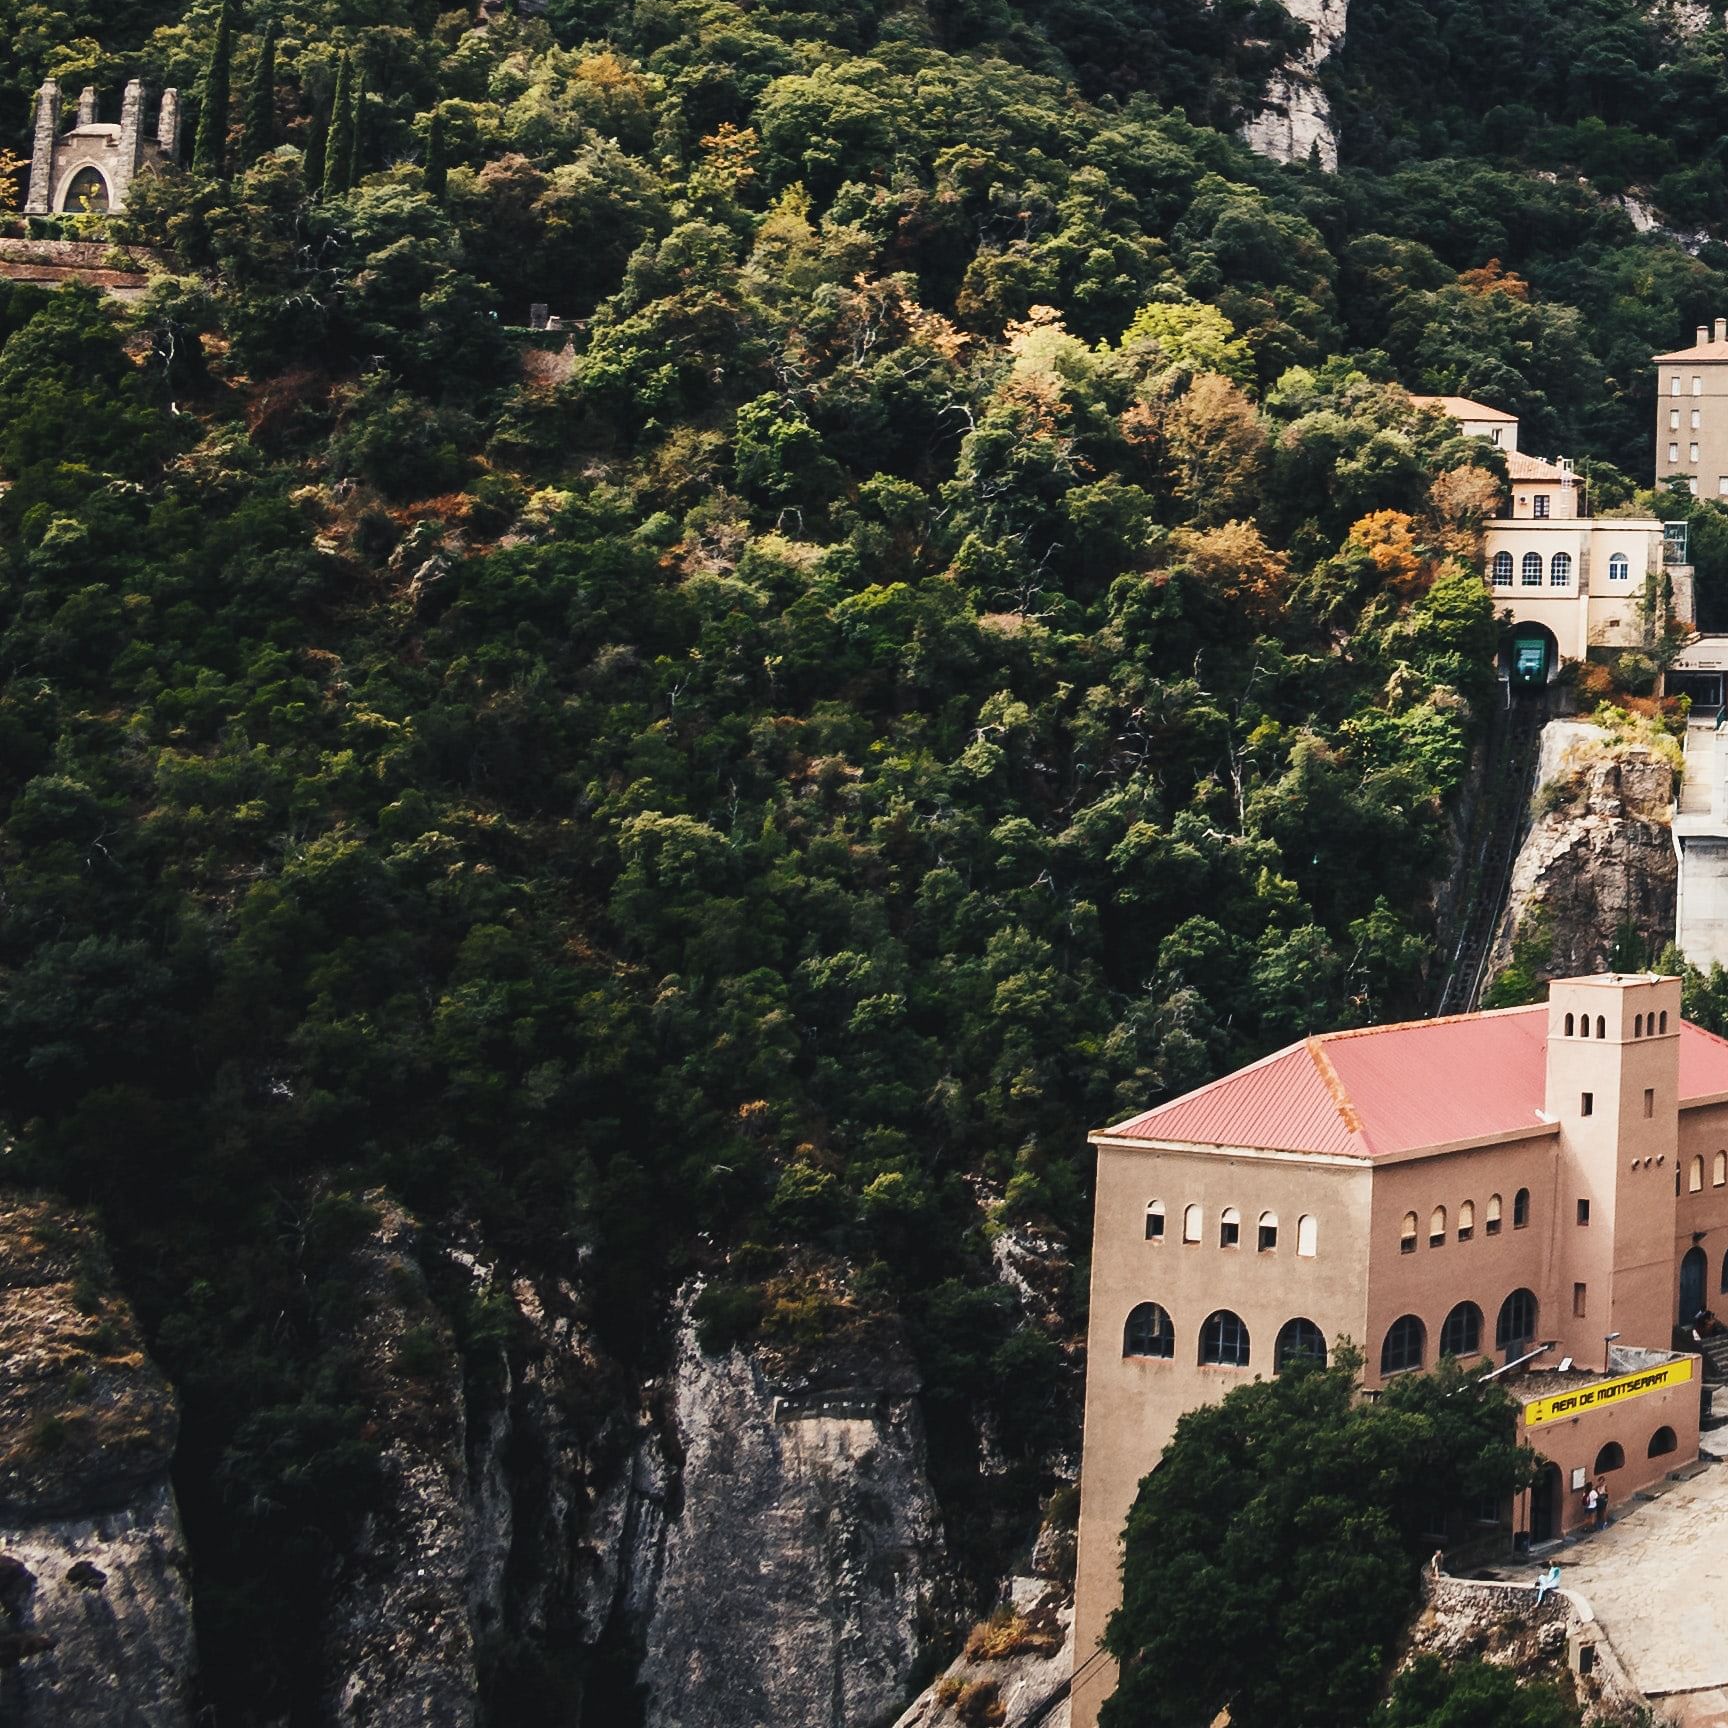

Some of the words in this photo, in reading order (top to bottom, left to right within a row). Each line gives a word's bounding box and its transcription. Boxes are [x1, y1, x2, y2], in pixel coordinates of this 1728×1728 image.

[1551, 1396, 1577, 1413] AERI
[1579, 1392, 1595, 1405] DE
[1597, 1371, 1669, 1401] MONTSERRAT
